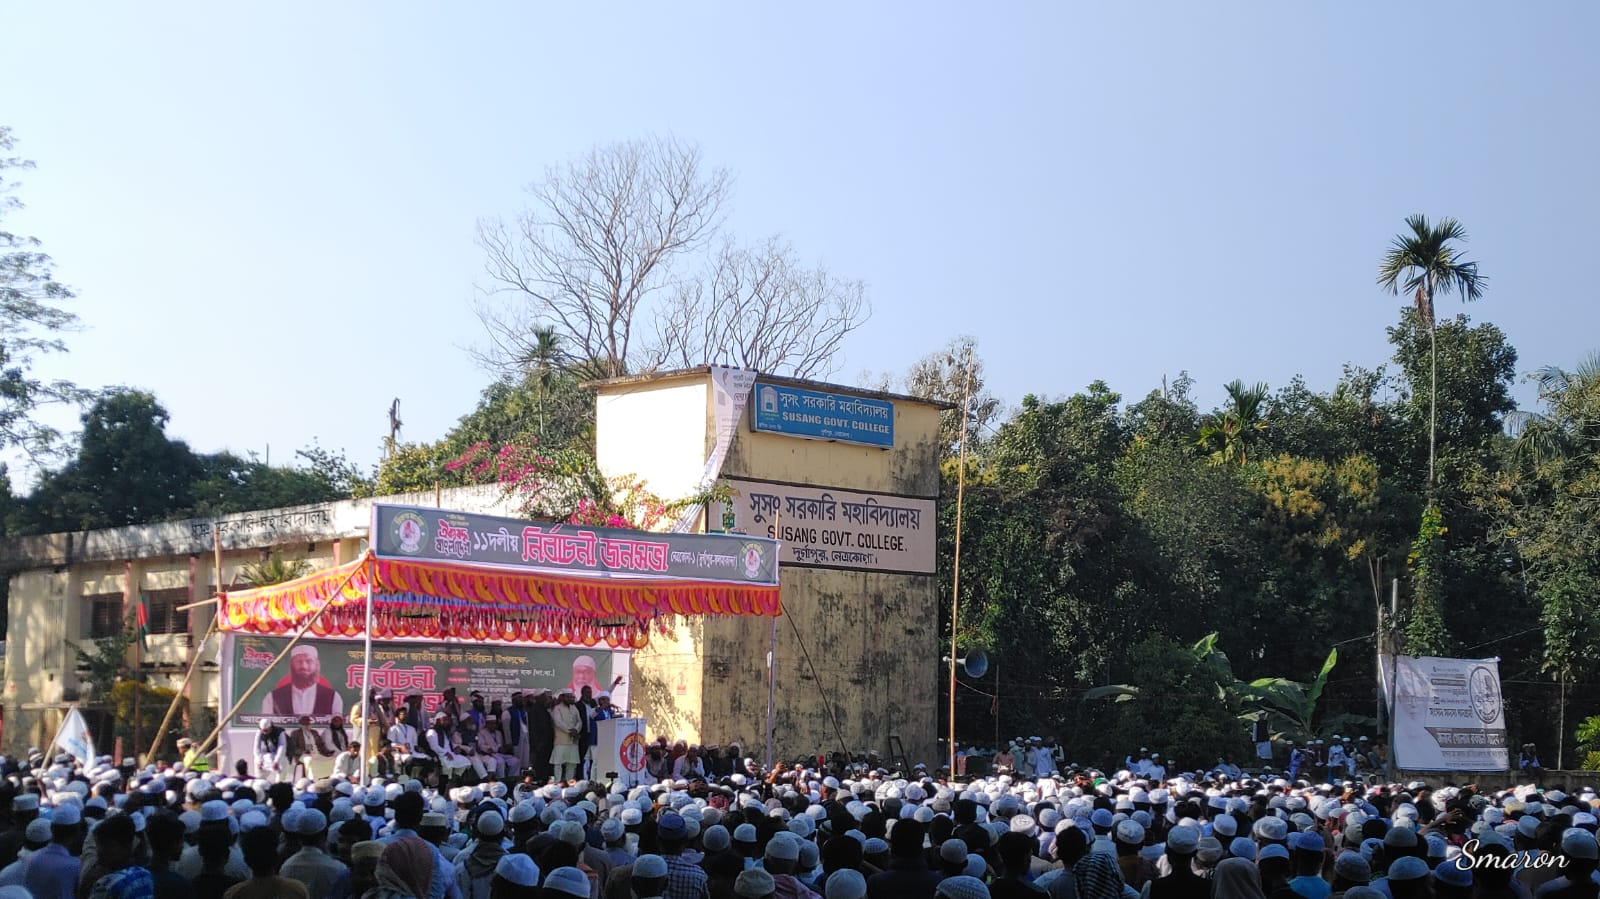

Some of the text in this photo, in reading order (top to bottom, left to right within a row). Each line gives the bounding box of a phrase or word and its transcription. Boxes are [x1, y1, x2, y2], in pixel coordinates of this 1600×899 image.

[780, 392, 888, 419] সুসং সরকারি মহাবিদ্যালয়
[782, 412, 822, 425] SUSANG
[823, 416, 850, 428] GOVT.
[852, 420, 890, 434] COLLEGE
[750, 492, 921, 530] সুসং সরকারি মহাবিদ্যালয়
[522, 523, 597, 566] নির্বাচনী
[599, 538, 669, 572] জনসভা
[767, 524, 908, 552] SUSANG GOVT. COLLEGE.
[792, 545, 829, 564] দুর্গাপুর,
